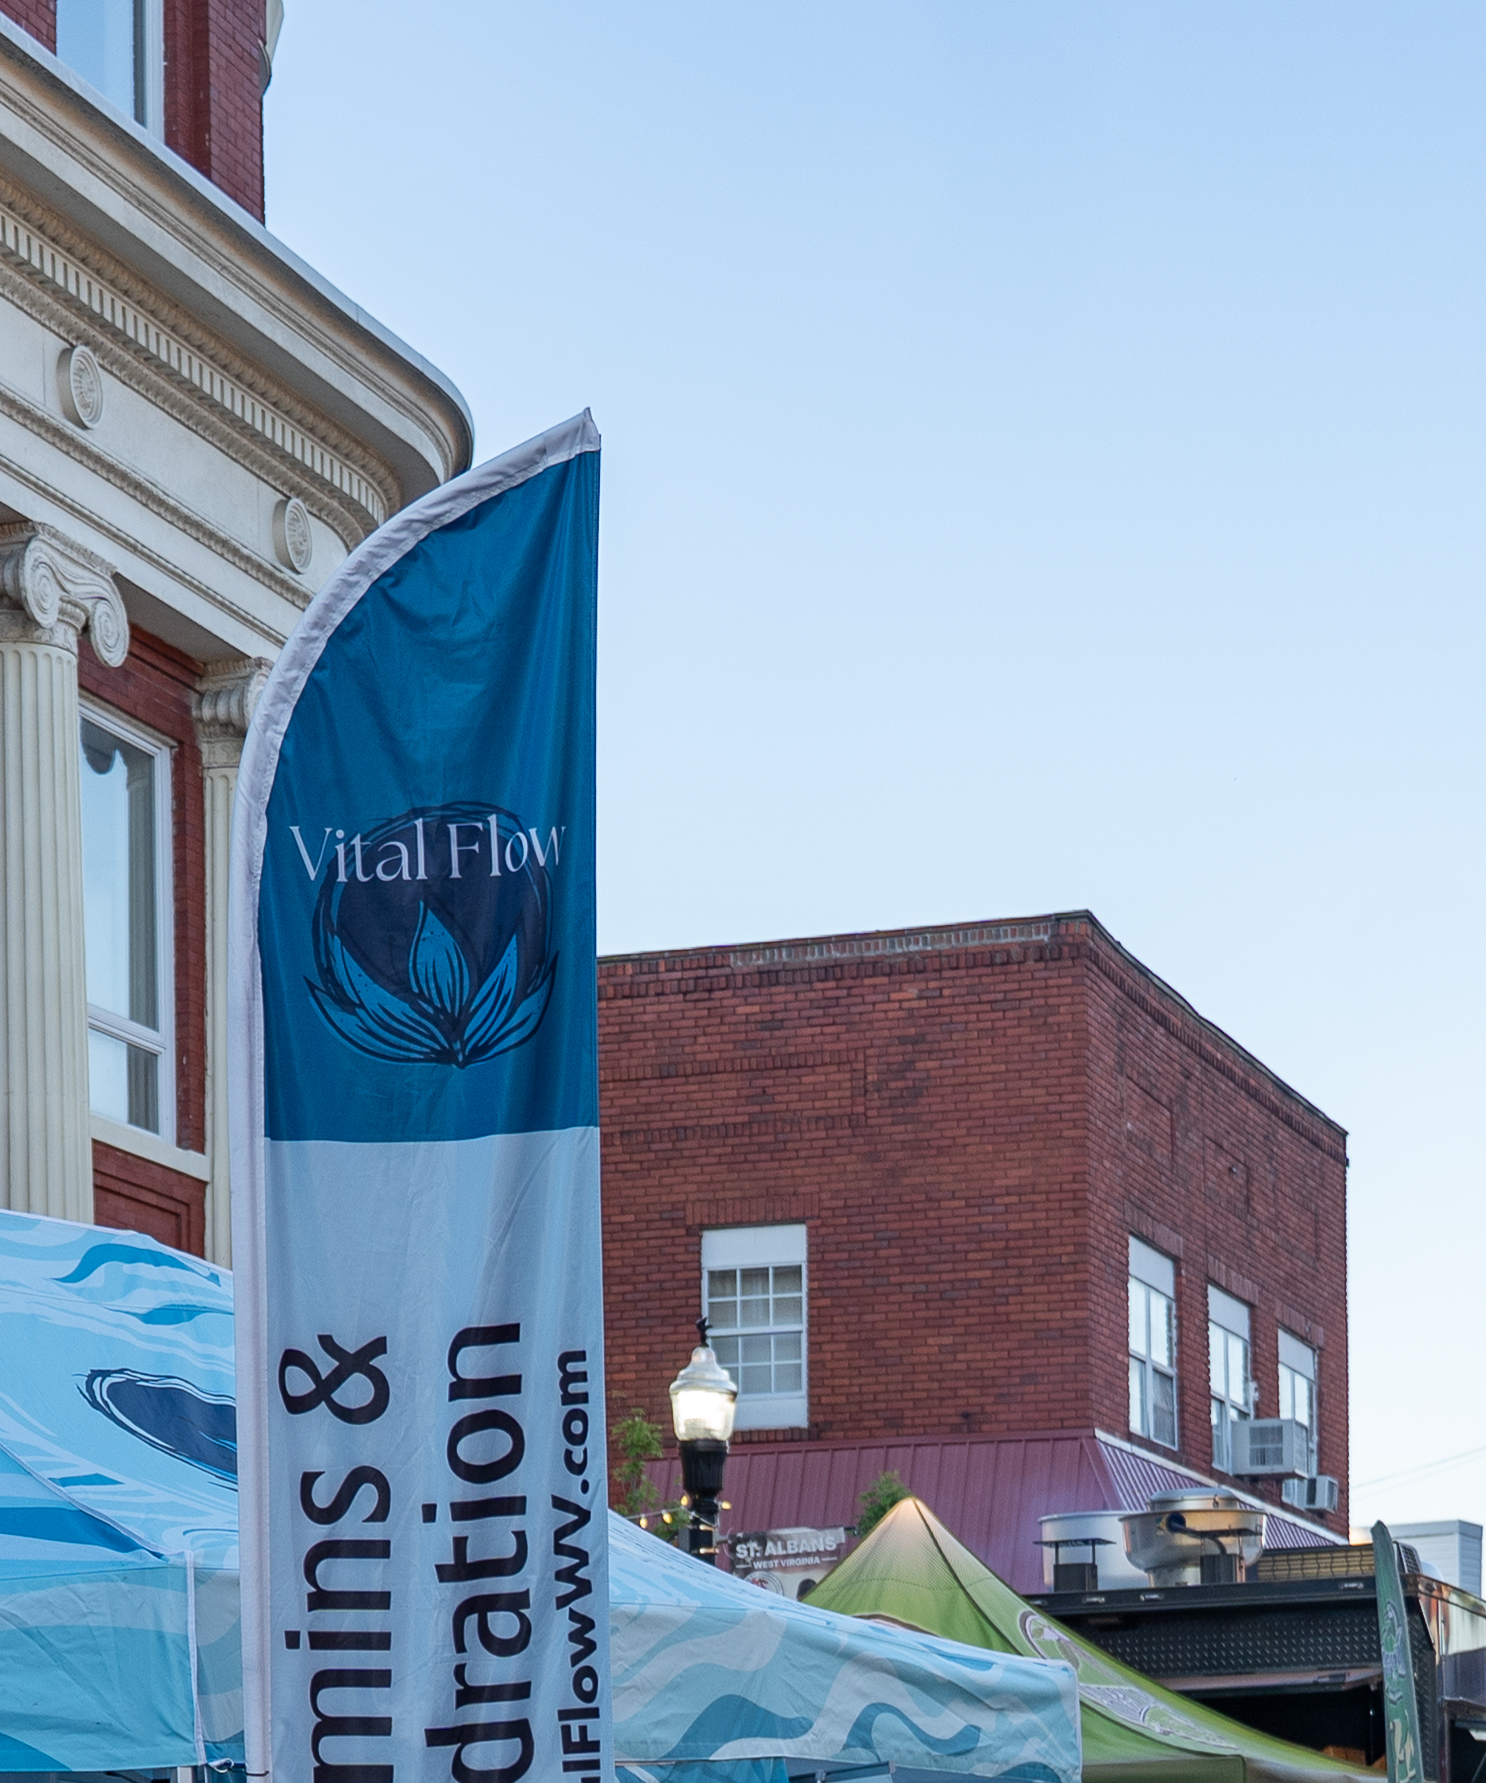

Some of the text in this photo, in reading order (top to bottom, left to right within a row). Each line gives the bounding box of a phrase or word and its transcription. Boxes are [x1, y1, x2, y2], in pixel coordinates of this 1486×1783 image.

[289, 813, 566, 883] Vital Flow
[279, 1333, 390, 1426] &
[736, 1536, 836, 1559] ST. ALBANS
[753, 1556, 821, 1570] WEST VIRGINIA
